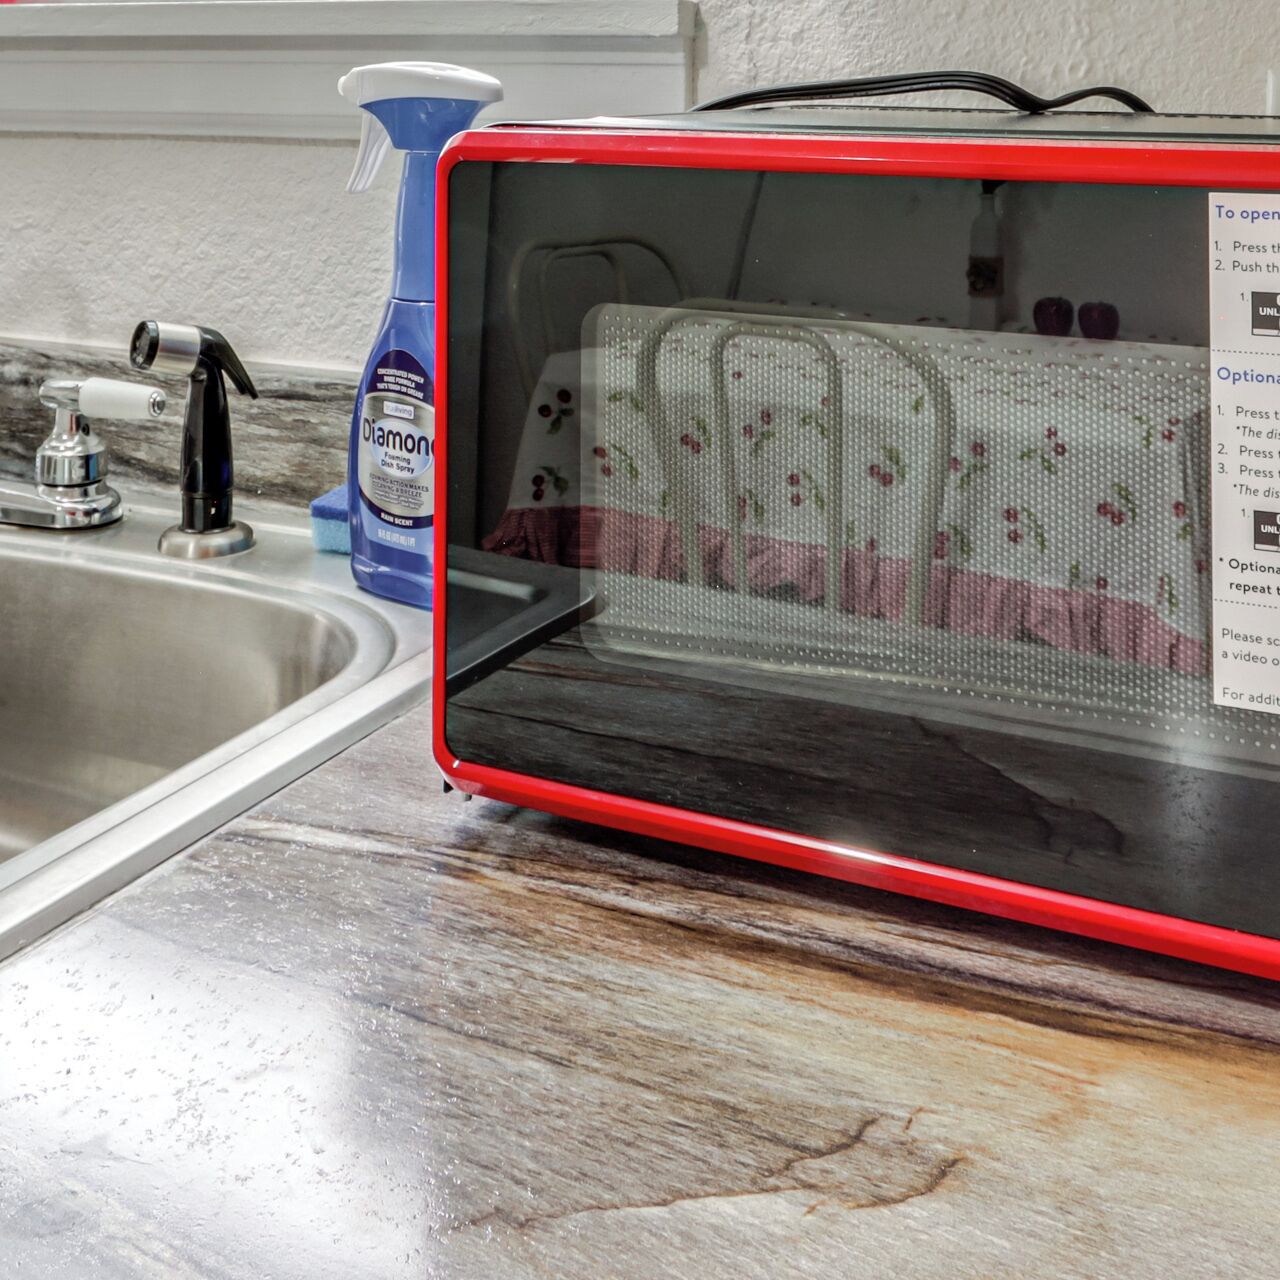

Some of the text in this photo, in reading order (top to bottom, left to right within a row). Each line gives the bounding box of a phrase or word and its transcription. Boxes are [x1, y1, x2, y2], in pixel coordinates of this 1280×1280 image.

[1216, 205, 1235, 219] To
[1240, 209, 1280, 224] open
[1214, 241, 1222, 252] 1.
[1233, 241, 1267, 253] Press
[1215, 260, 1225, 272] 2.
[1232, 260, 1262, 273] Push
[1235, 406, 1270, 420] Press
[384, 451, 411, 466] Foaming
[1217, 443, 1228, 456] 2.
[1239, 445, 1274, 460] Press
[381, 459, 415, 475] Dish Spray
[1217, 462, 1228, 474] 3.
[1239, 464, 1274, 479] Press
[1229, 581, 1272, 596] repeat
[1222, 628, 1263, 644] Please
[1221, 650, 1228, 659] a
[1232, 650, 1268, 664] video
[1222, 687, 1244, 701] For
